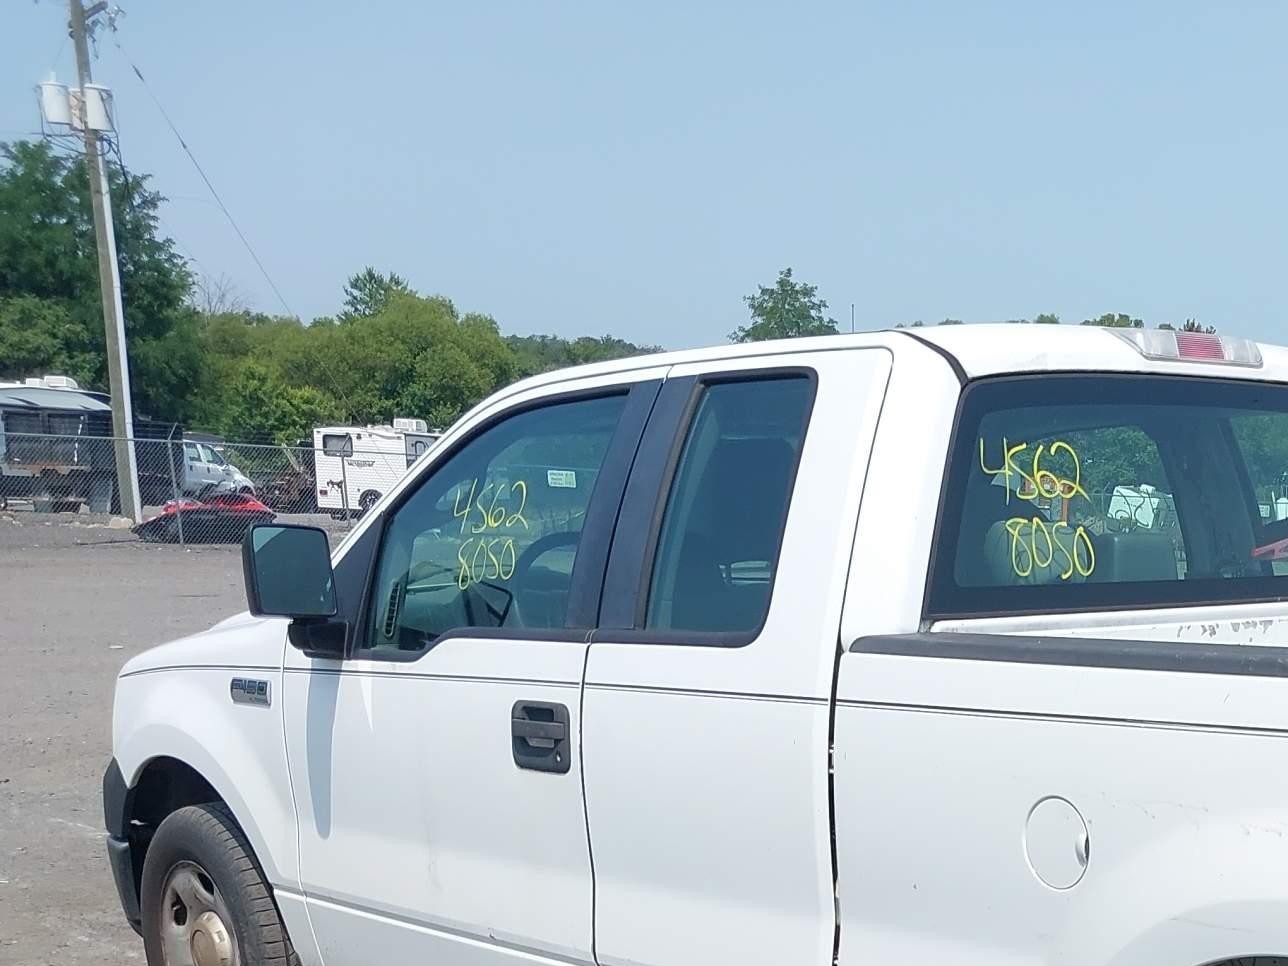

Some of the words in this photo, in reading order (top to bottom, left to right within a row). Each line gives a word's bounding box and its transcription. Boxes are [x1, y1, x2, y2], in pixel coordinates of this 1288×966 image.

[979, 436, 1093, 506] 4562
[453, 477, 529, 534] 4562
[458, 537, 516, 590] 8050
[1005, 517, 1096, 580] 8050
